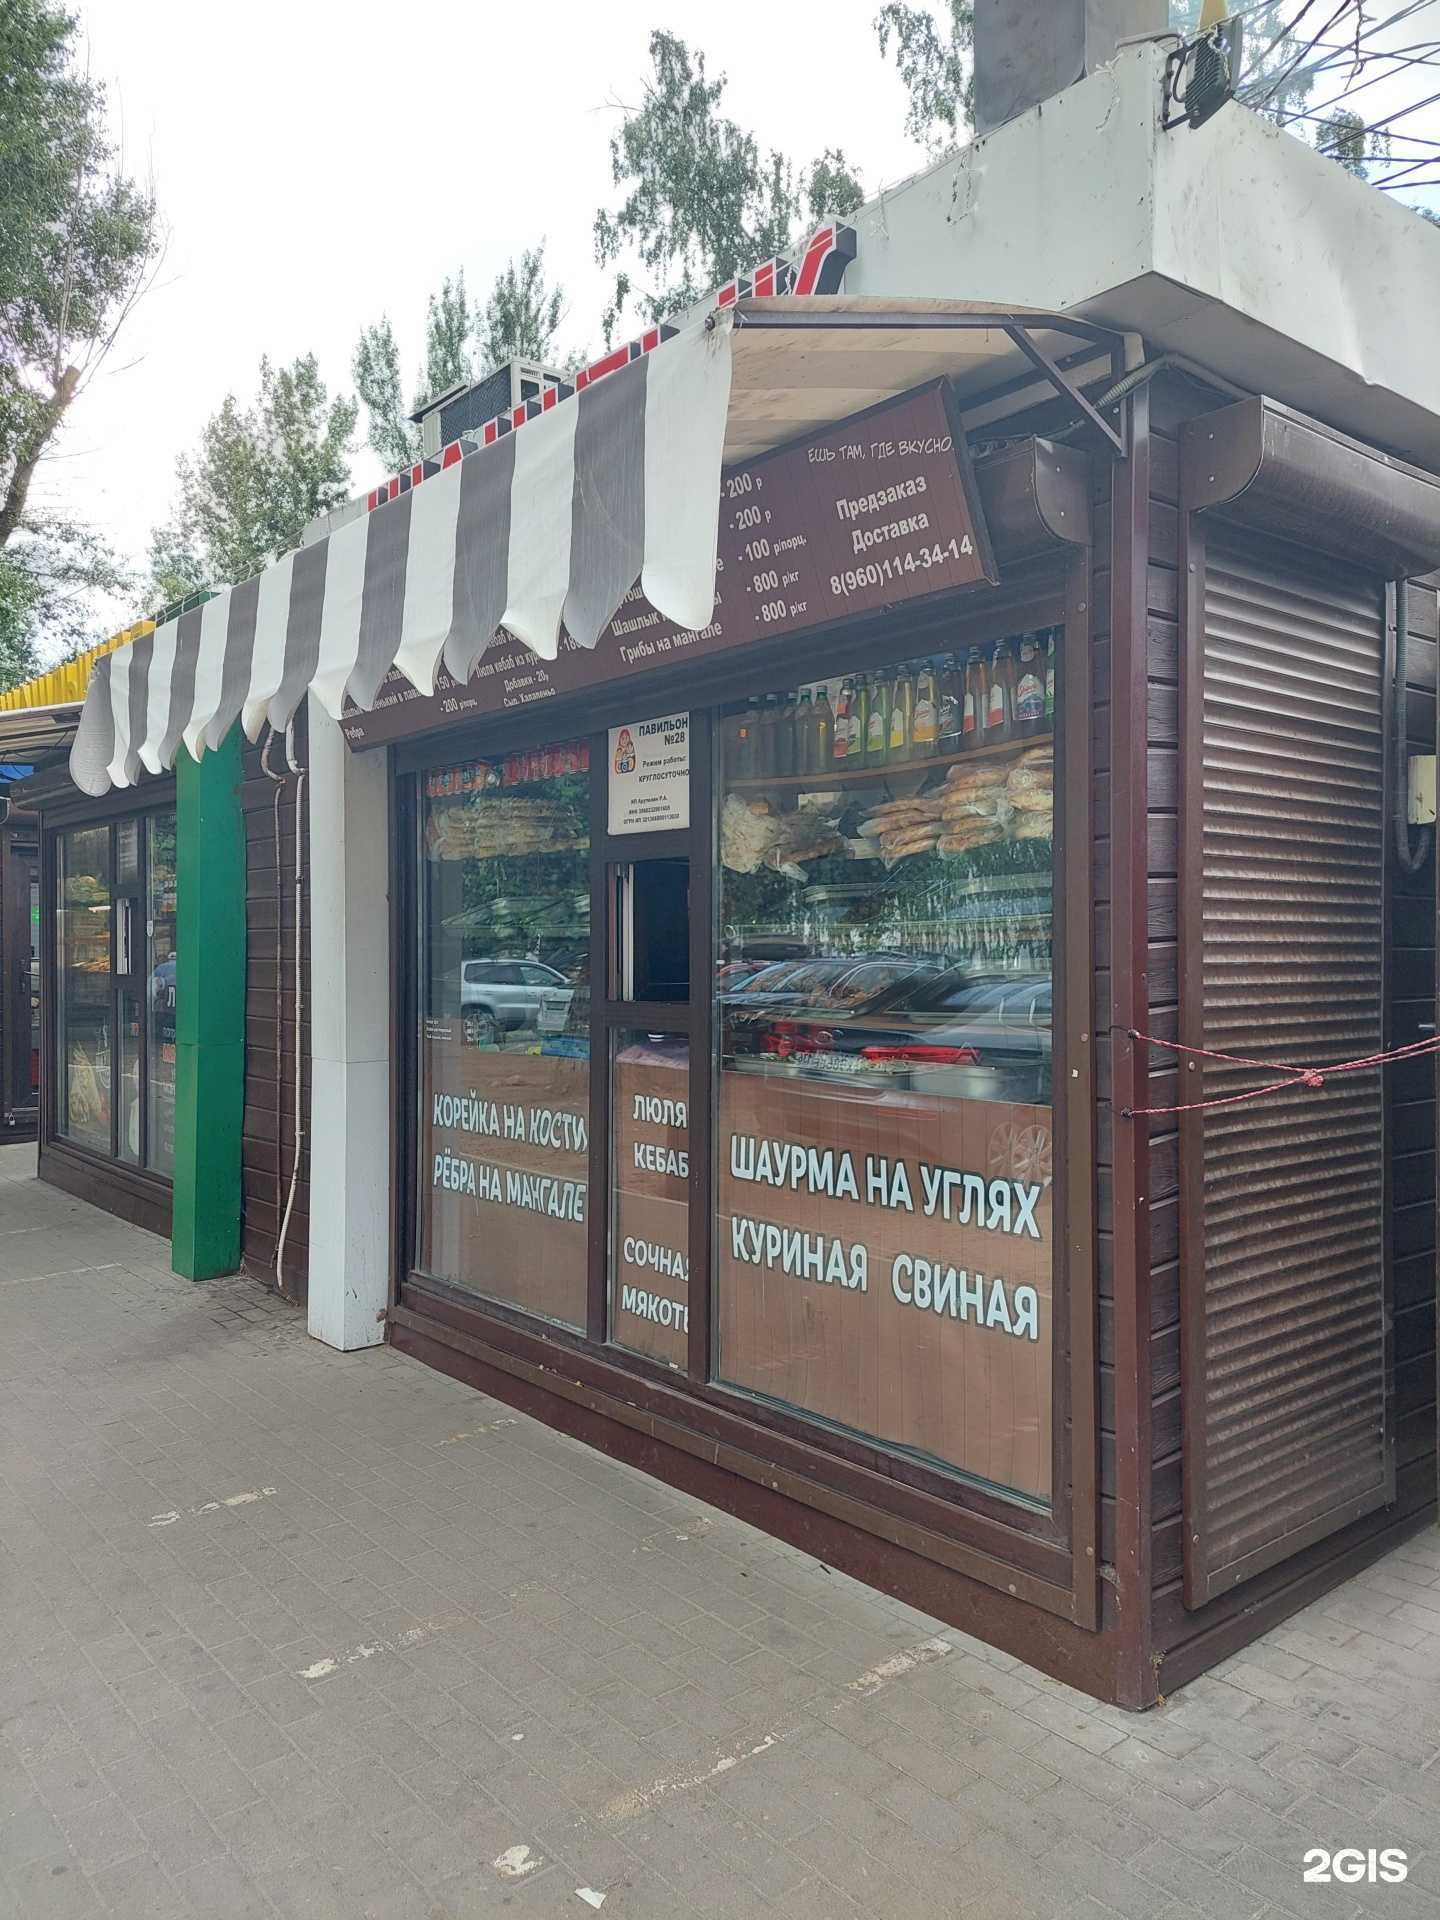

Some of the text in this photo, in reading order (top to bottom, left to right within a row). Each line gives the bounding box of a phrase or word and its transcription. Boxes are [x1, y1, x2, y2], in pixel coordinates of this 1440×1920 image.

[808, 449, 836, 463] ЕШЬ
[838, 444, 866, 460] ТАМ,
[870, 443, 895, 458] ГДЕ
[836, 475, 927, 521] Предзаказ
[851, 512, 929, 554] Доставка
[782, 570, 799, 588] р/кг
[829, 534, 974, 597] 8(960)114-34-14
[611, 612, 660, 637] Шашлык
[789, 601, 808, 618] р/кг
[619, 620, 723, 664] Грибы на мангале
[503, 676, 534, 694] Добавки
[639, 717, 688, 737] ПАВИЛЬОН
[664, 731, 685, 746] №28
[638, 768, 690, 783] КРУГЛОСУТОЧНО
[433, 1089, 588, 1153] КОРЕЙКА НА КОСТИ
[632, 1094, 688, 1129] ЛЮЛЯ
[633, 1141, 689, 1179] КЕБАБ
[433, 1147, 587, 1222] РЁБРА НА МАНГАЛЕ
[730, 1134, 1041, 1239] ШАУРМА НА УГЛЯХ
[623, 1236, 689, 1283] СОЧНА
[731, 1215, 1039, 1341] КУРИНАЯ СВИНАЯ
